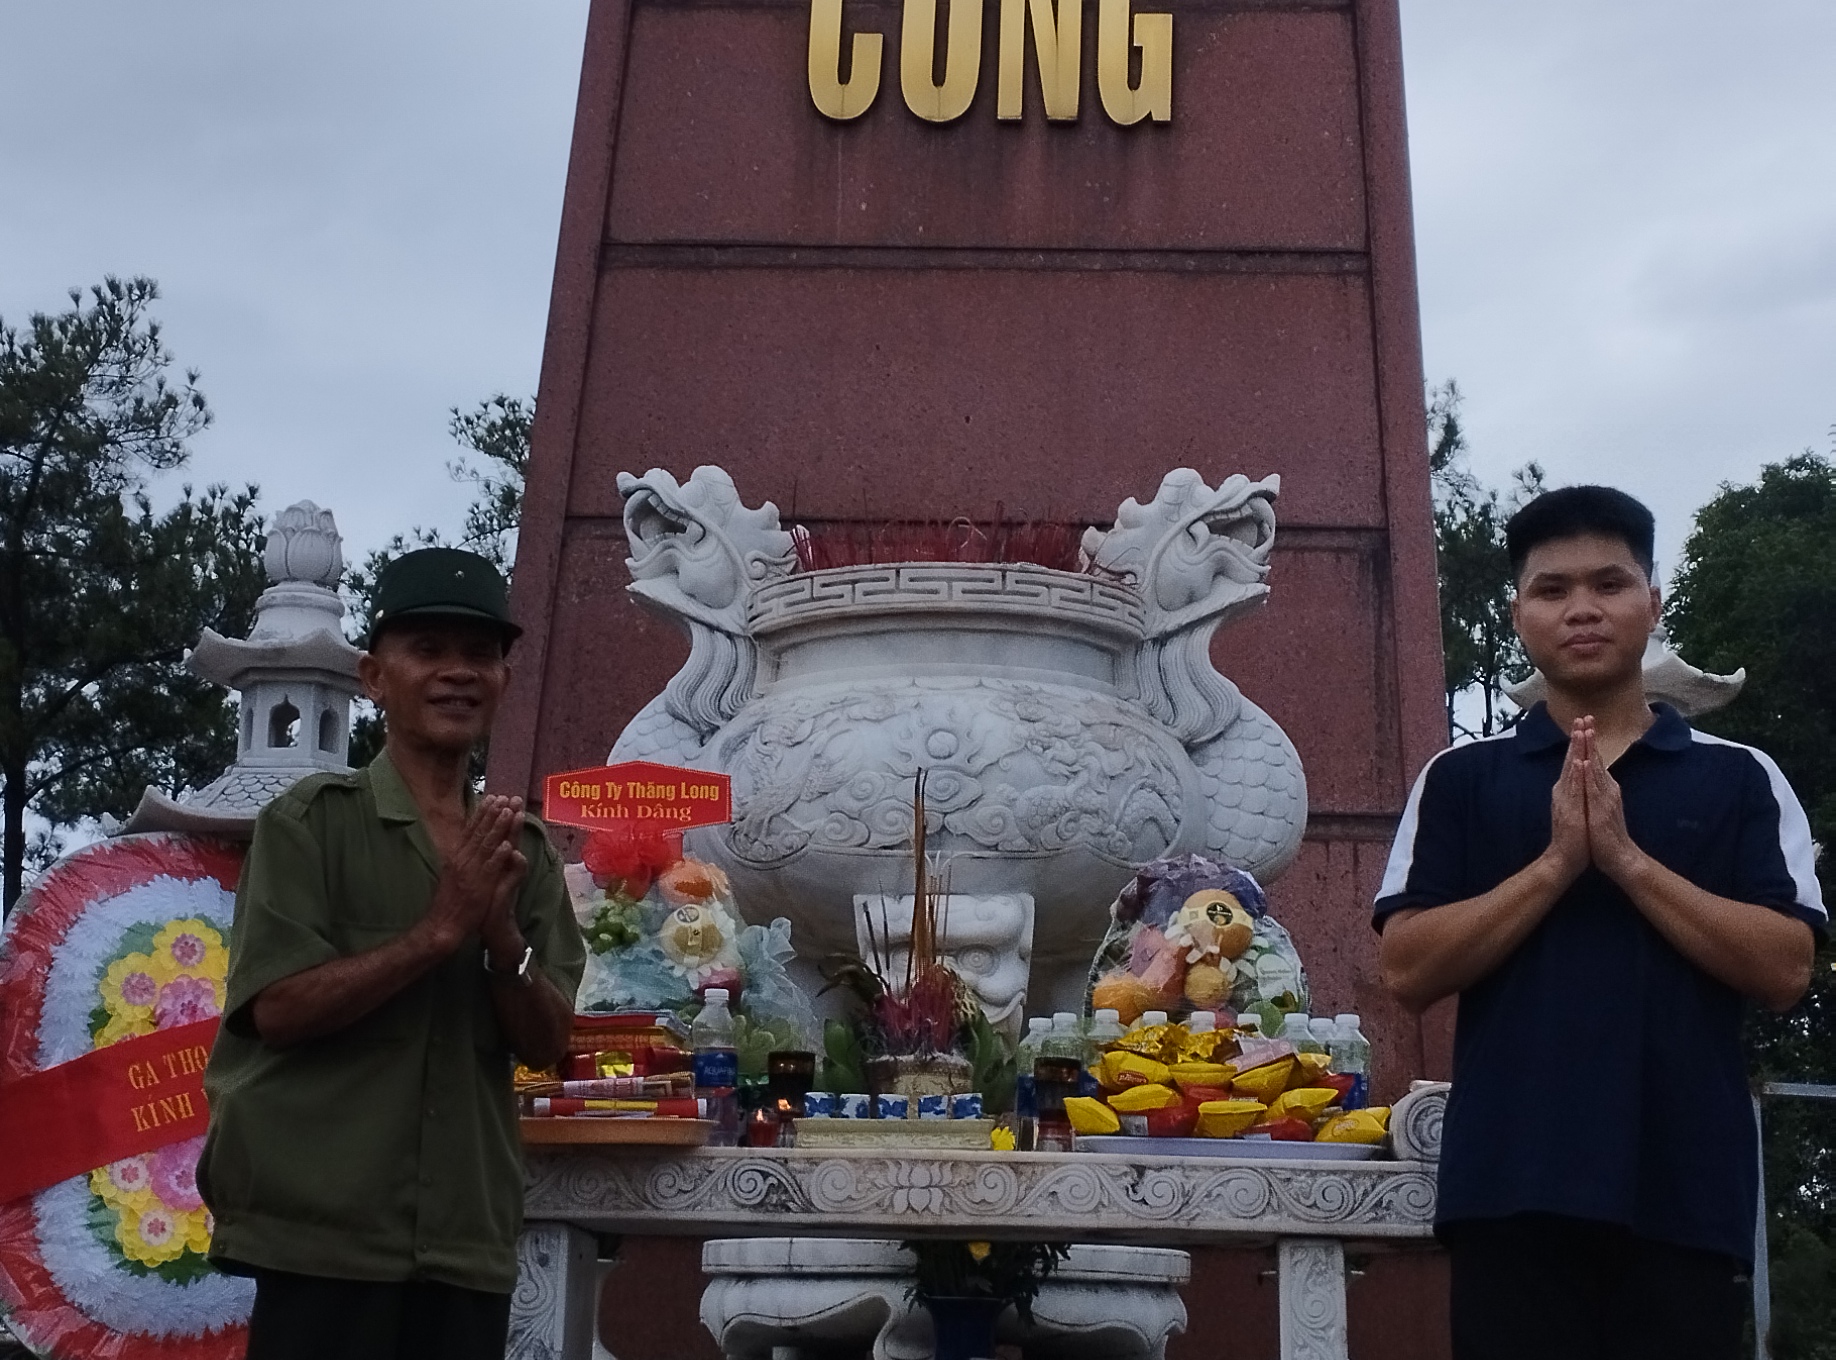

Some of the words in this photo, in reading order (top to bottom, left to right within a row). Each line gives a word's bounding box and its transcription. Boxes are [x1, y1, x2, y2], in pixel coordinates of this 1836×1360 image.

[559, 781, 601, 800] Công
[626, 781, 676, 801] Thăng
[680, 782, 720, 802] Long
[580, 802, 630, 819] Kính
[636, 803, 692, 822] Dâng
[128, 1060, 160, 1090] GA
[130, 1092, 195, 1132] KÍNH
